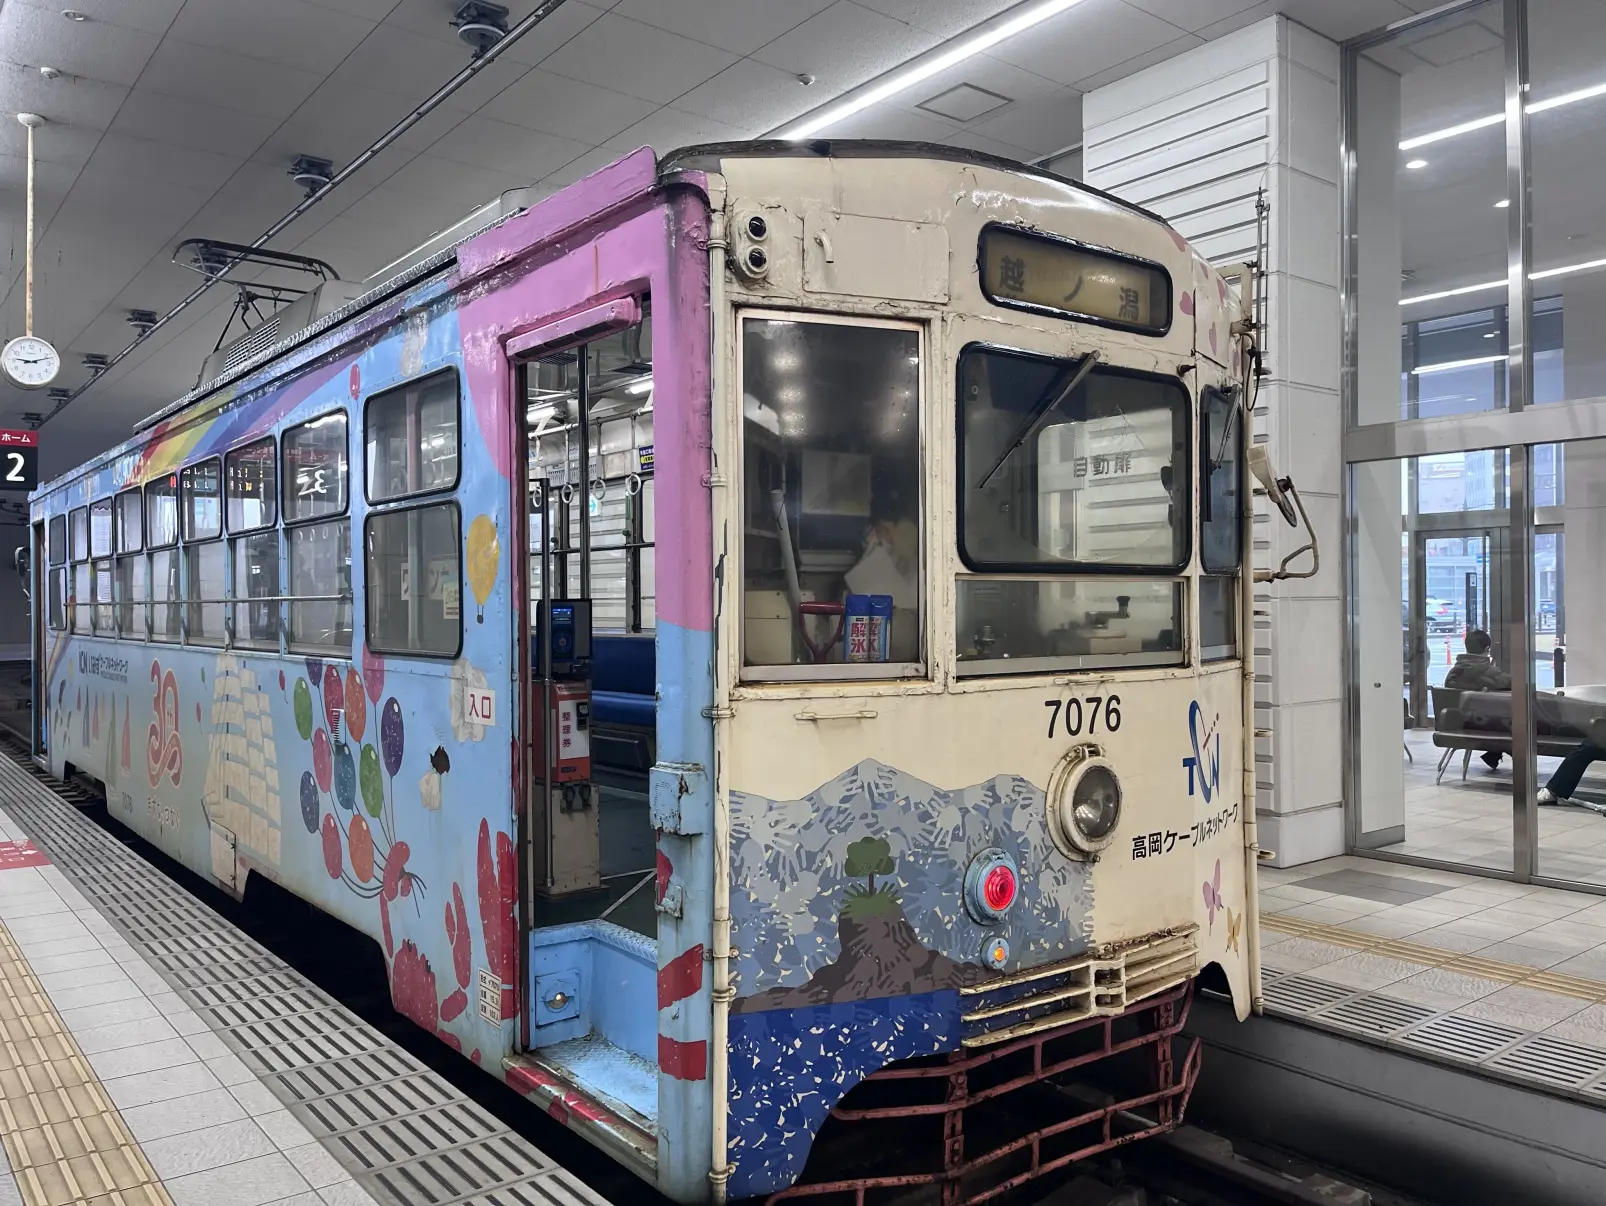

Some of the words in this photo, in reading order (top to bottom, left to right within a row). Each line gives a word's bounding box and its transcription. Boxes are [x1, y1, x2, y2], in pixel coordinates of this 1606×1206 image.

[1, 432, 31, 443] ホーム
[6, 452, 25, 482] 2
[469, 693, 492, 719] 入口
[1045, 694, 1121, 739] 7076
[562, 711, 572, 748] 整理券
[1132, 803, 1238, 861] 高岡ケーブルネットワーク
